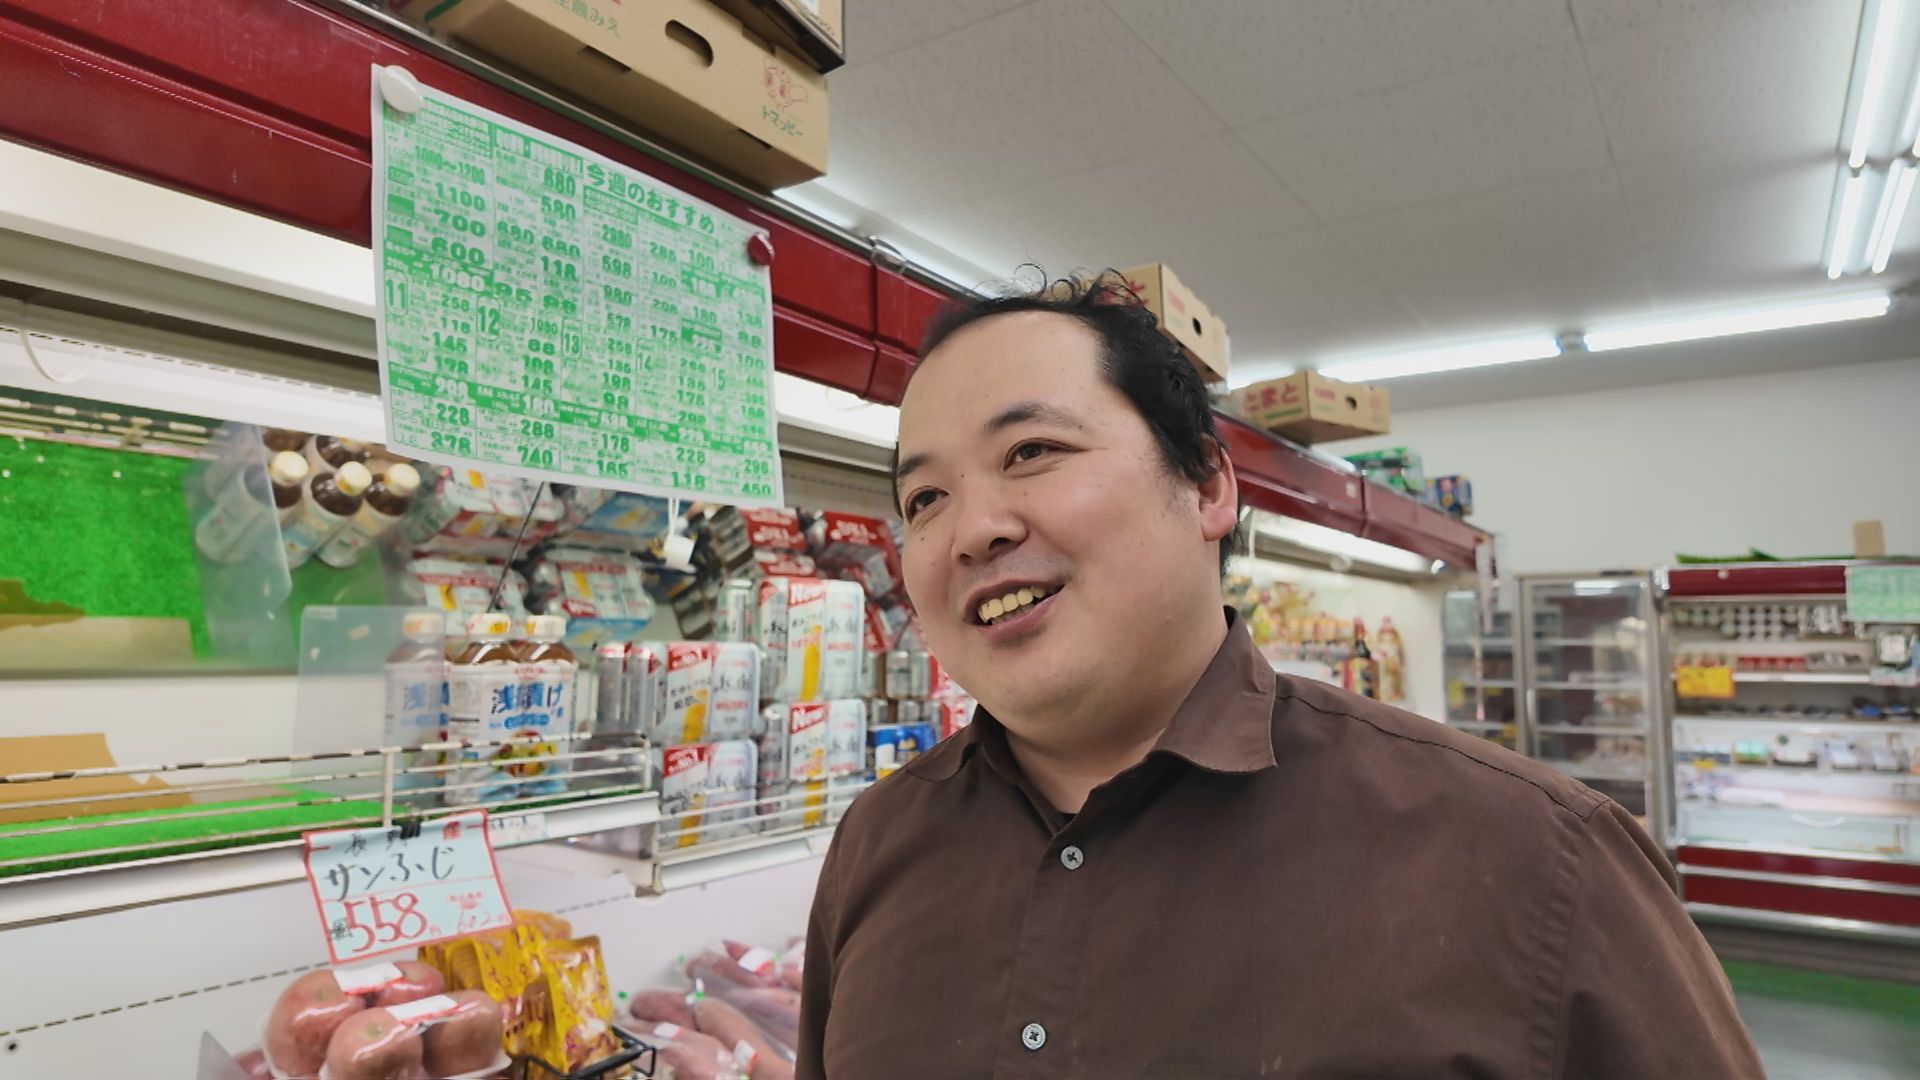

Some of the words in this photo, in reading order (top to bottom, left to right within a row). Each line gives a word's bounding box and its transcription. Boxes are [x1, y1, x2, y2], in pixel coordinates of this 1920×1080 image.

[435, 182, 485, 212] 1100
[586, 162, 715, 235] 今週のおすすめ
[433, 209, 486, 238] 700
[384, 279, 405, 309] 11
[479, 307, 501, 337] 12
[436, 403, 470, 426] 228
[676, 447, 706, 466] 228
[671, 471, 705, 491] 118
[490, 682, 565, 715] 浅漬け
[343, 892, 428, 953] 558
